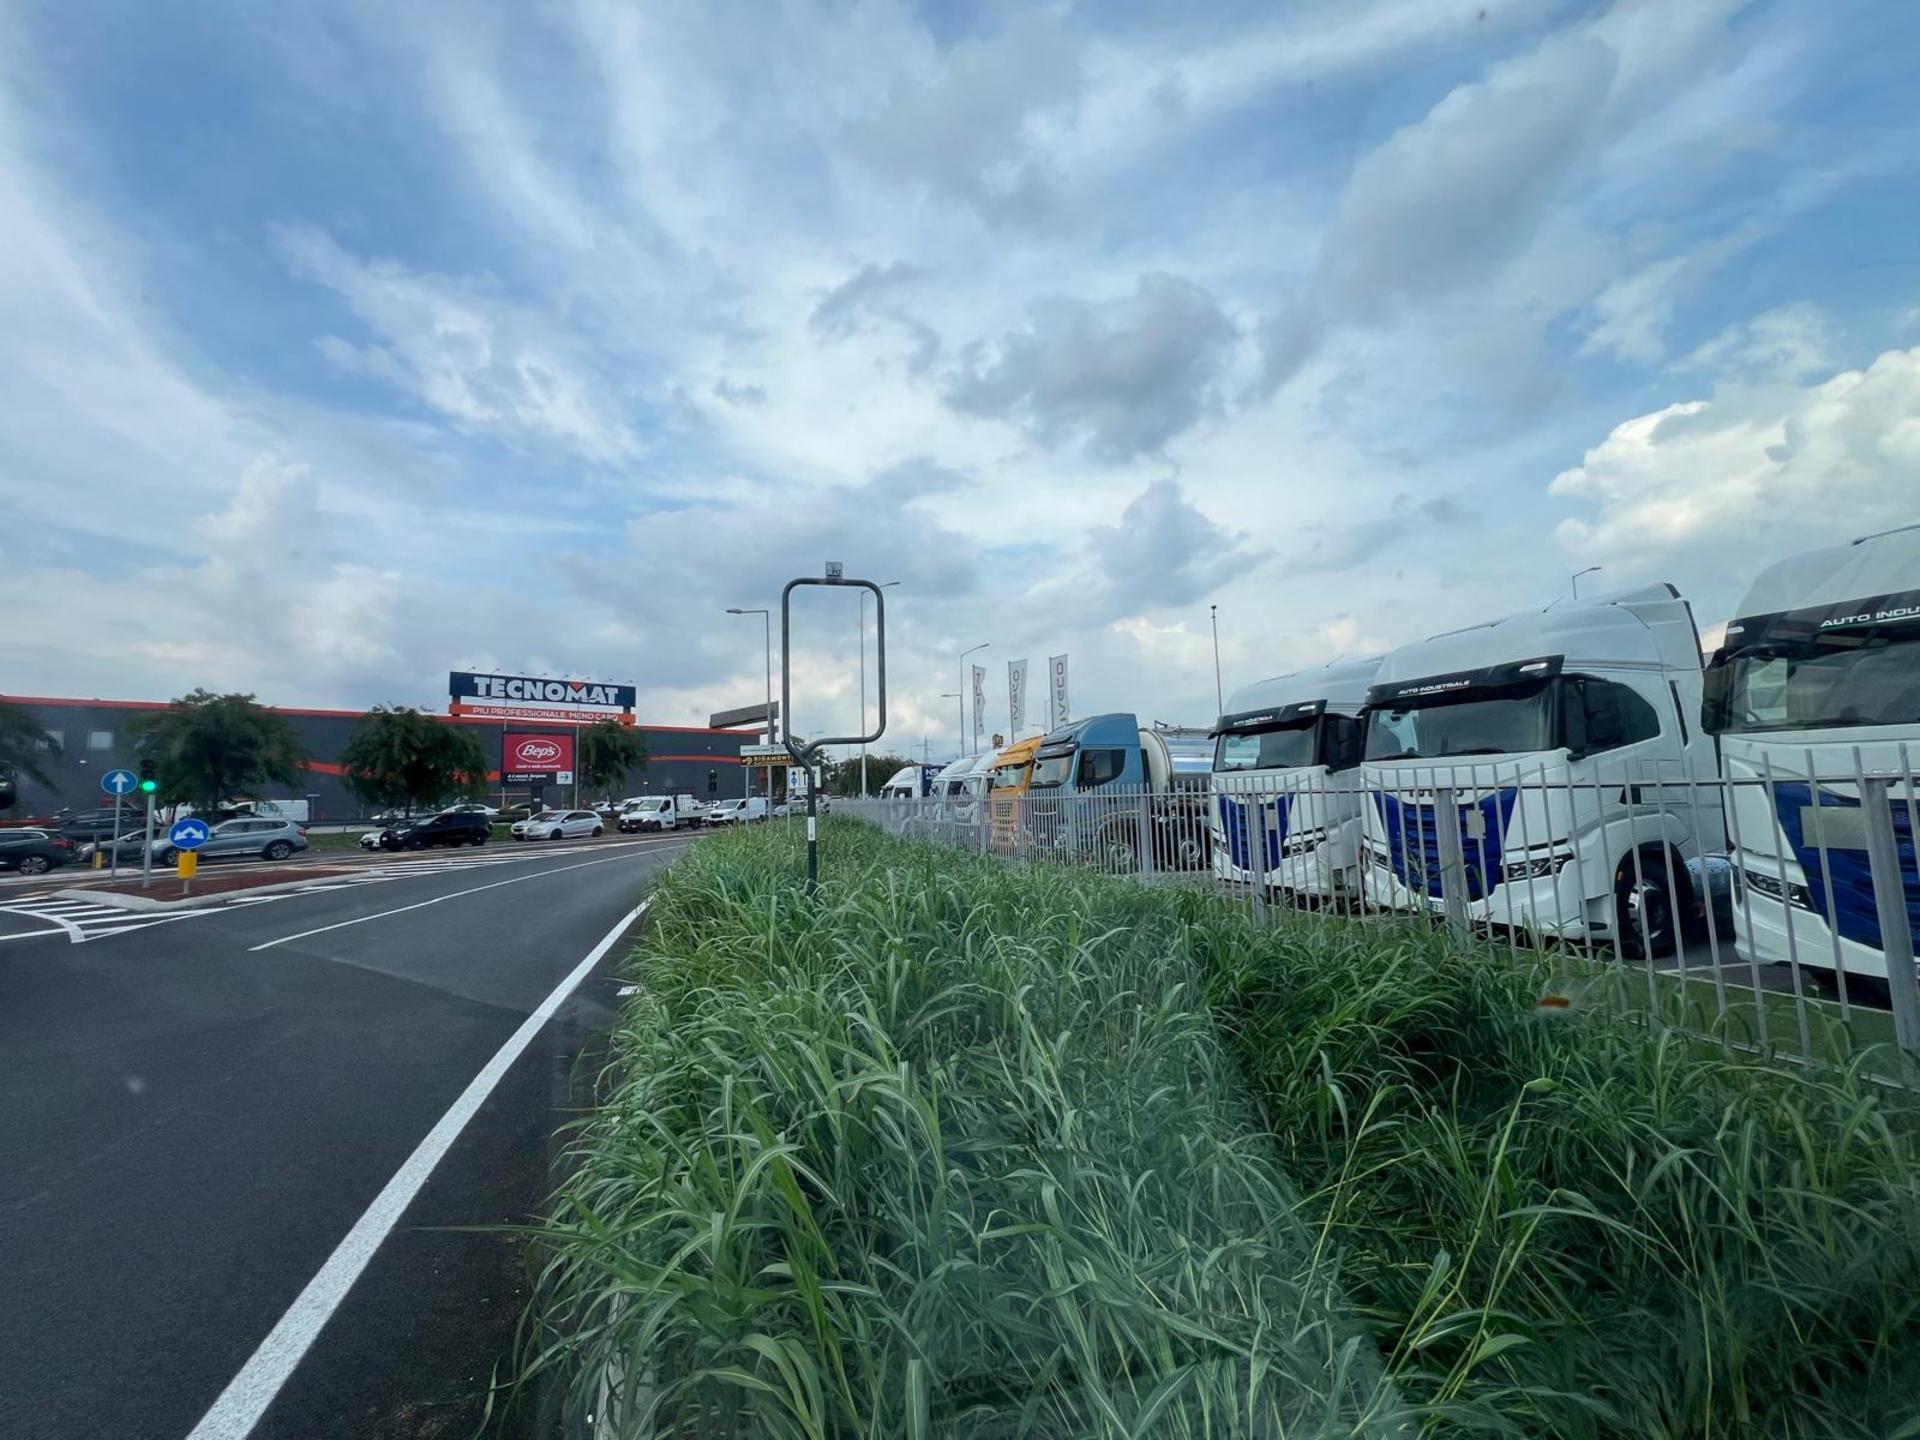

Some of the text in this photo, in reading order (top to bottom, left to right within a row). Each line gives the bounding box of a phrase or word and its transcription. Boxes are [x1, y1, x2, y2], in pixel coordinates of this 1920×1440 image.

[1819, 614, 1870, 628] AUTO
[473, 676, 619, 705] TECNOMAT
[1398, 680, 1470, 696] AUTO INDUSTRIALE
[569, 711, 594, 720] MENO
[594, 712, 619, 722] CARO
